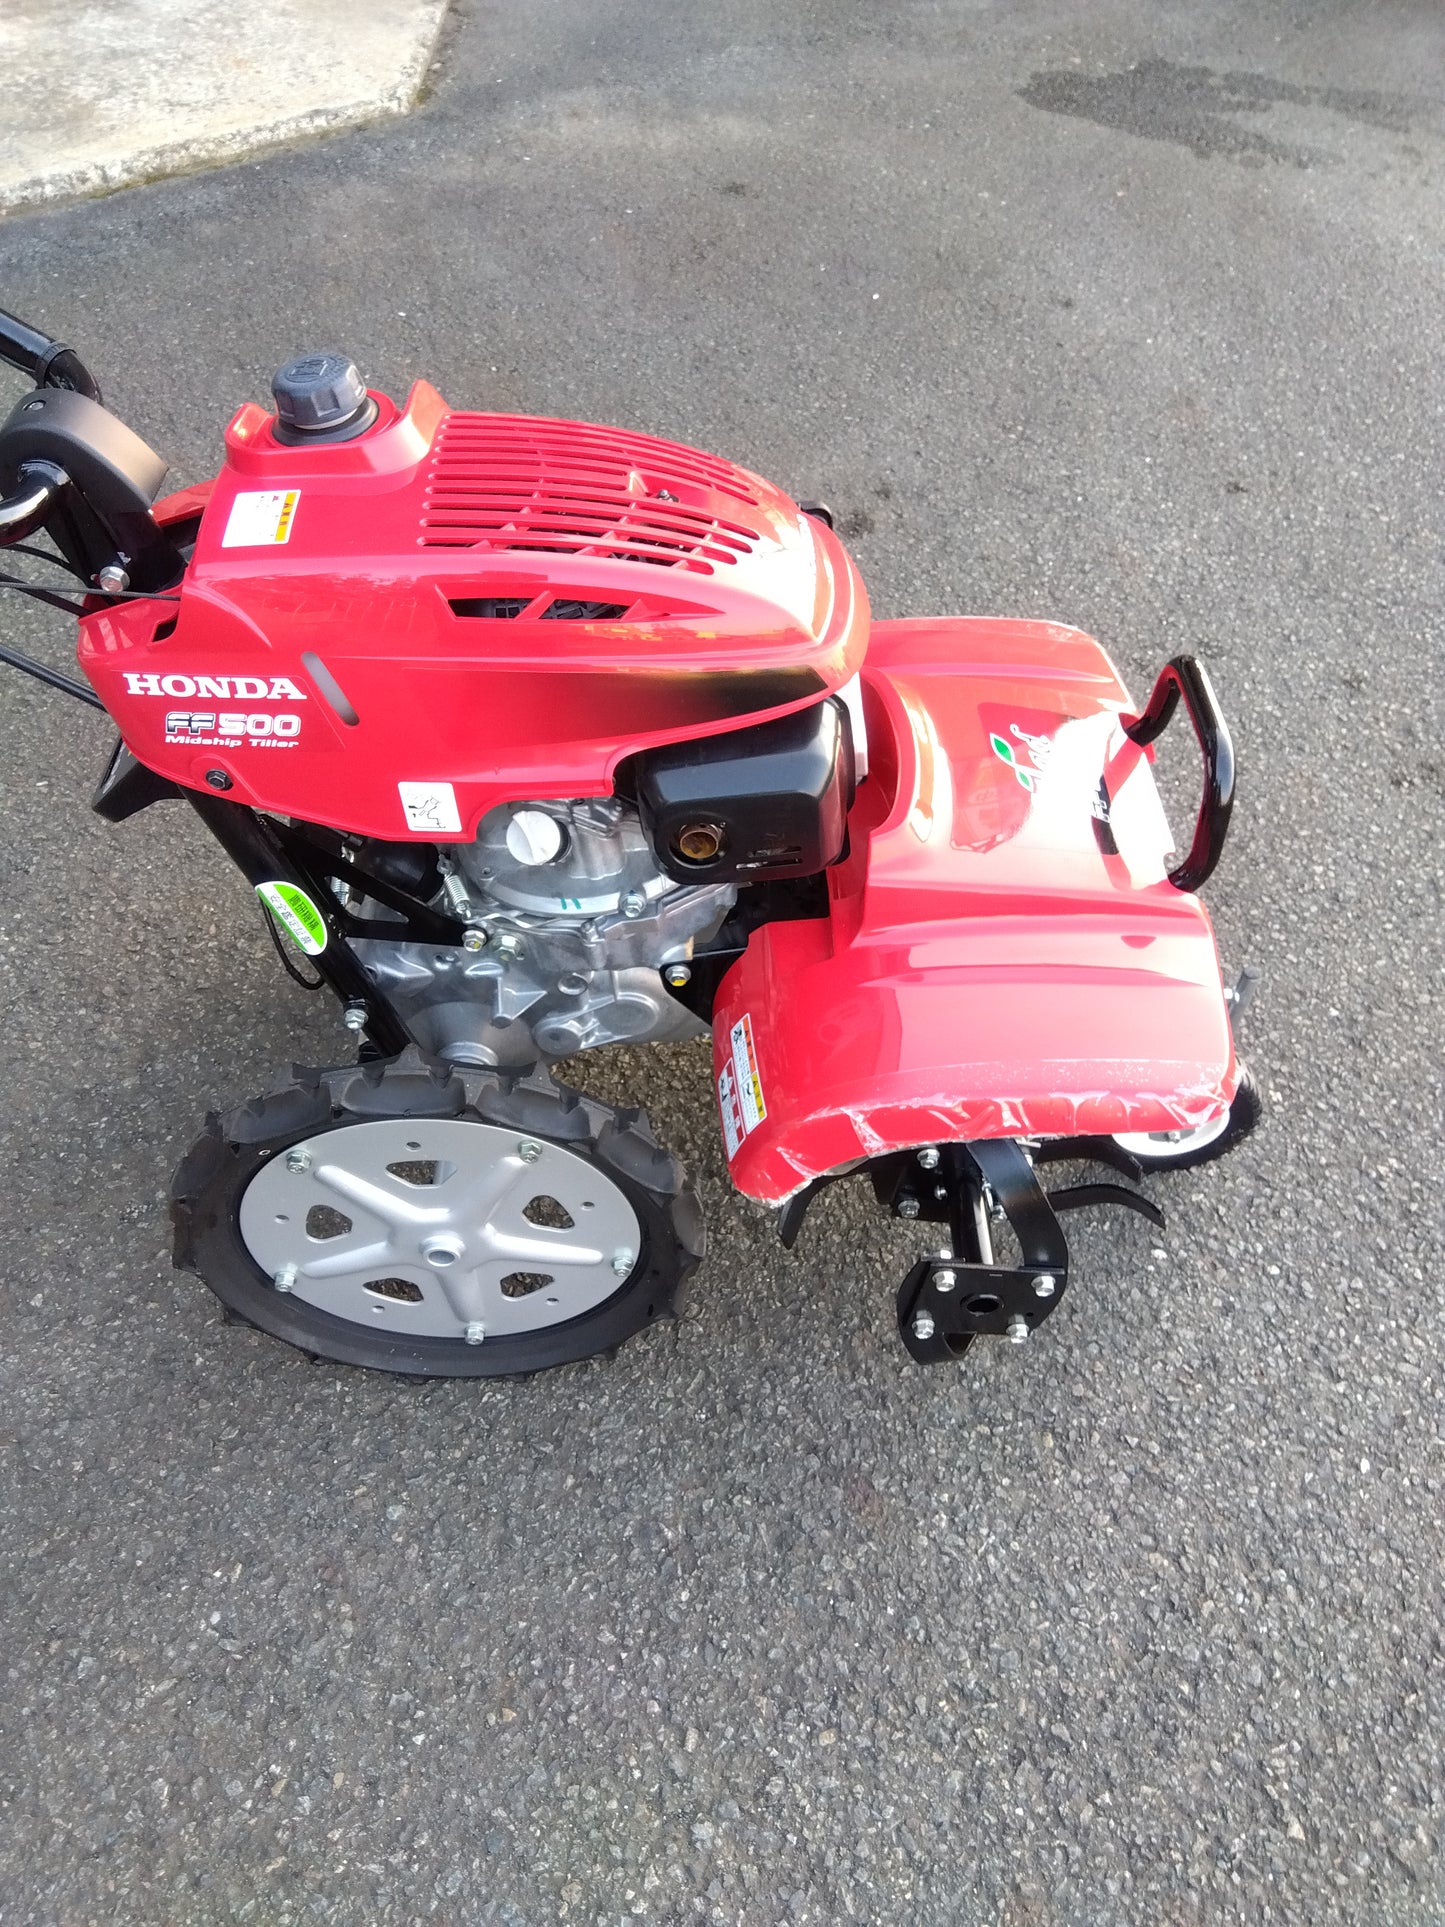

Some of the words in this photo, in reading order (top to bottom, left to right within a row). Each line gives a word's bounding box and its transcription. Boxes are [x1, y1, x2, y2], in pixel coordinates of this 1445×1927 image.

[122, 673, 308, 700] HONDA
[165, 735, 243, 748] Midship
[249, 738, 299, 748] Tiller
